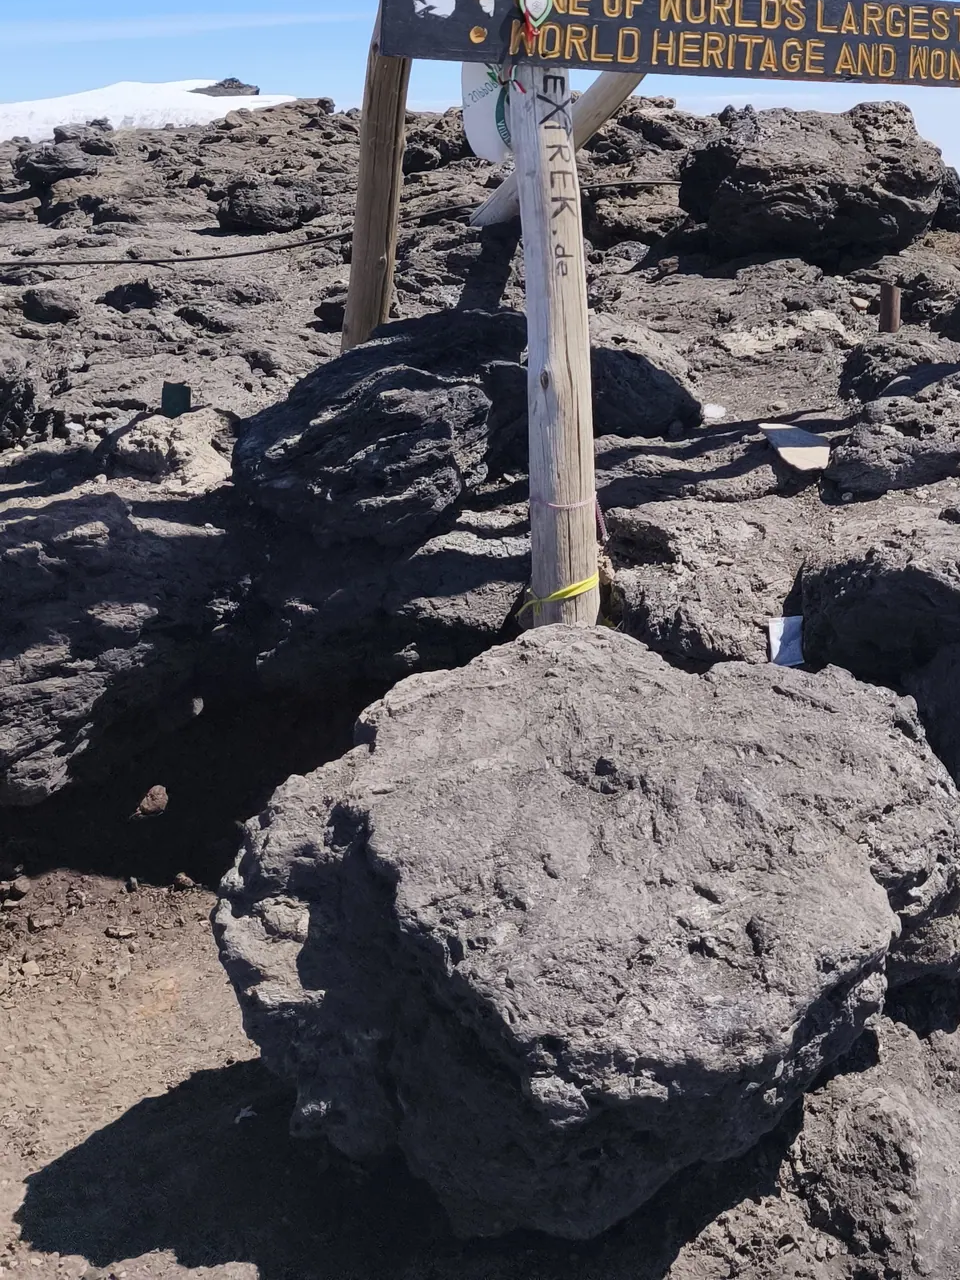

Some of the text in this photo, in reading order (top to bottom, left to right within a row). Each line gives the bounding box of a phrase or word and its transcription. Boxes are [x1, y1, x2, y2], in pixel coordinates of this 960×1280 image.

[509, 18, 641, 64] WORLD
[652, 28, 826, 74] HERITAGE
[834, 41, 897, 77] AND
